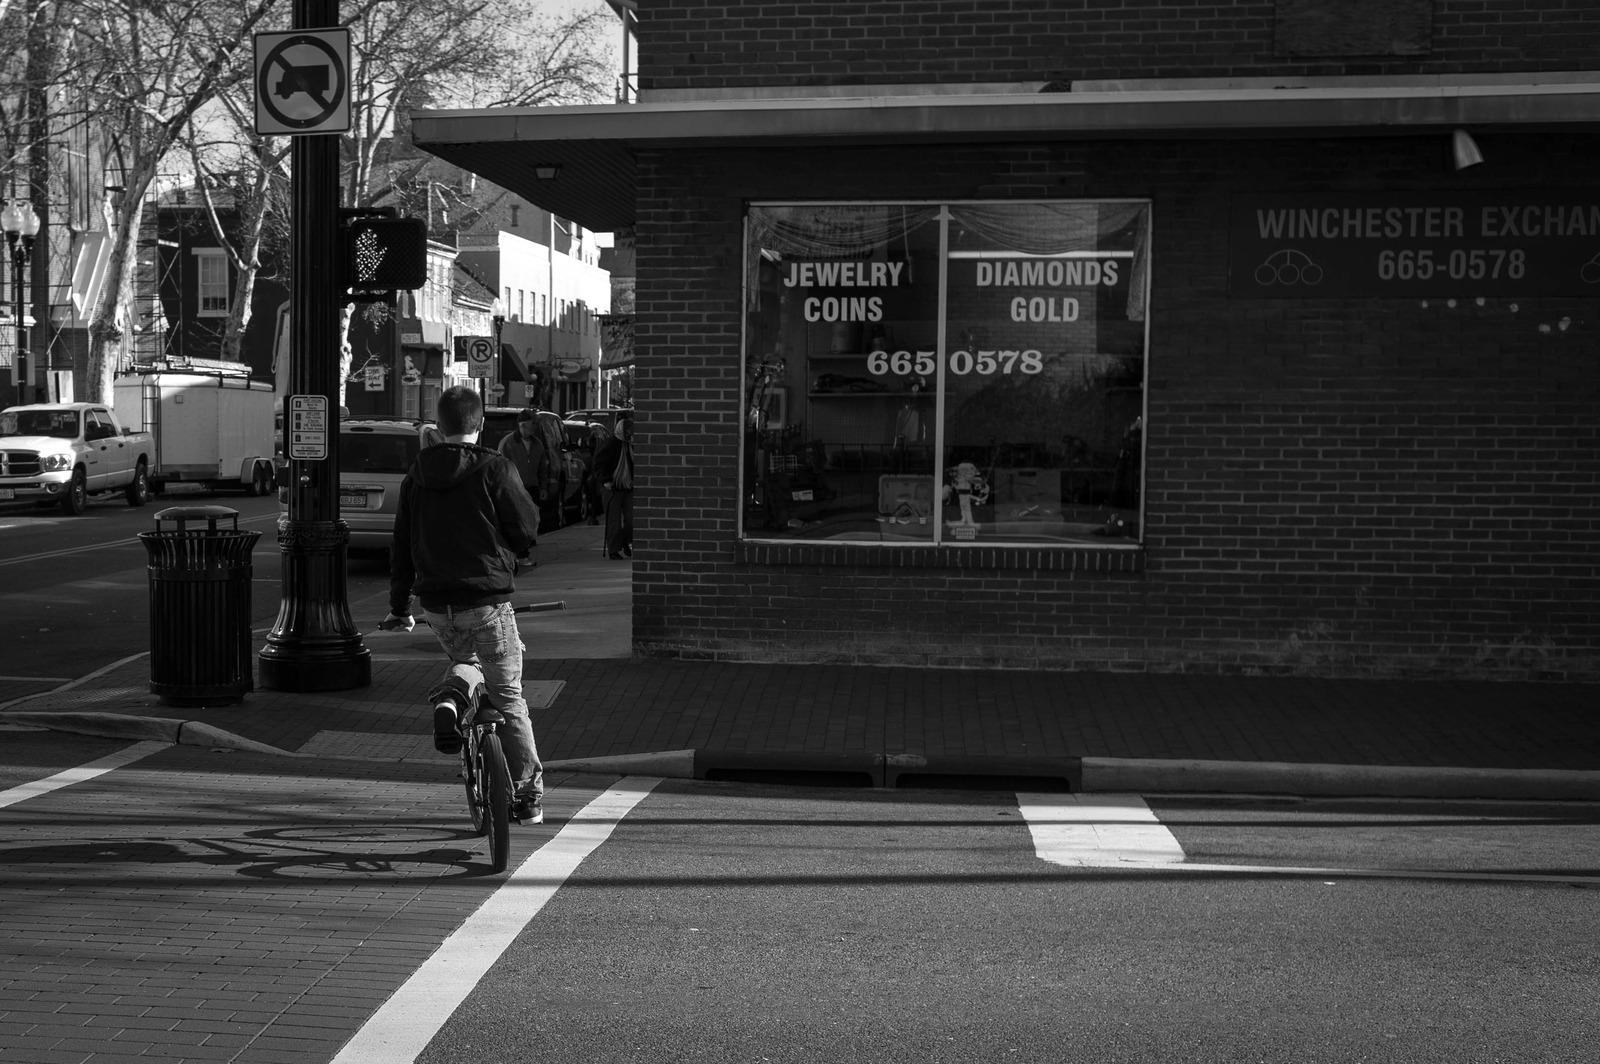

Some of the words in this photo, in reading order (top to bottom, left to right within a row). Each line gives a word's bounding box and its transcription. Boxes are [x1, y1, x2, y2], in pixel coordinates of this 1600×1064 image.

[1256, 206, 1464, 240] WINCHESTER
[783, 261, 904, 288] JEWELRY
[976, 260, 1119, 287] DIAMONDS
[1378, 248, 1526, 281] 665-0578
[804, 296, 883, 323] COINS
[1010, 296, 1080, 323] GOLD
[866, 350, 936, 376] 665
[949, 349, 1044, 376] 0578
